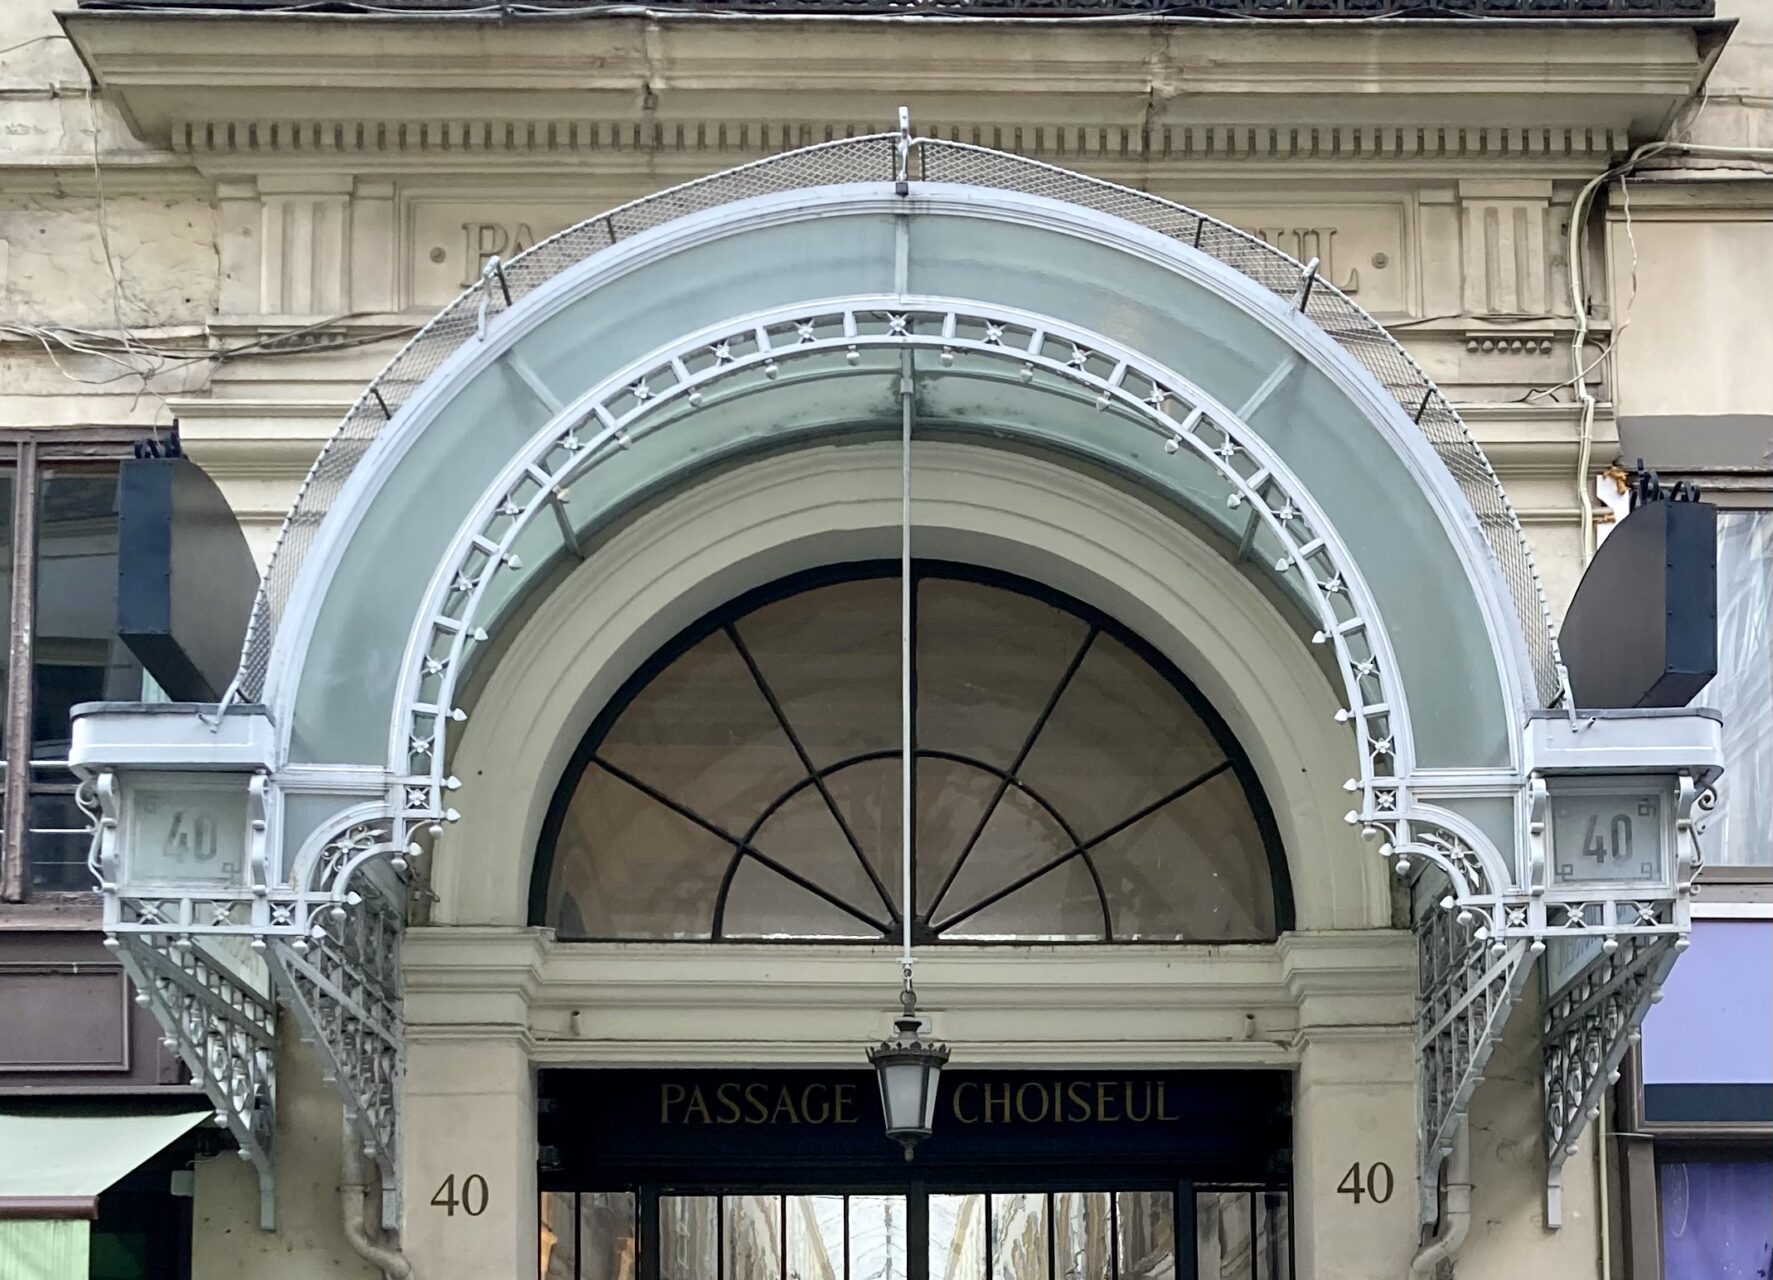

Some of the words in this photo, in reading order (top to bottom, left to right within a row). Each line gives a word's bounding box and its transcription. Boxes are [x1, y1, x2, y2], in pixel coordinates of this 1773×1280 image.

[163, 811, 218, 863] 40
[1582, 813, 1634, 864] 40
[660, 1082, 859, 1124] PASSAGE
[952, 1080, 1181, 1124] CHOISEUL
[430, 1173, 489, 1217] 40
[1336, 1161, 1394, 1204] 40
